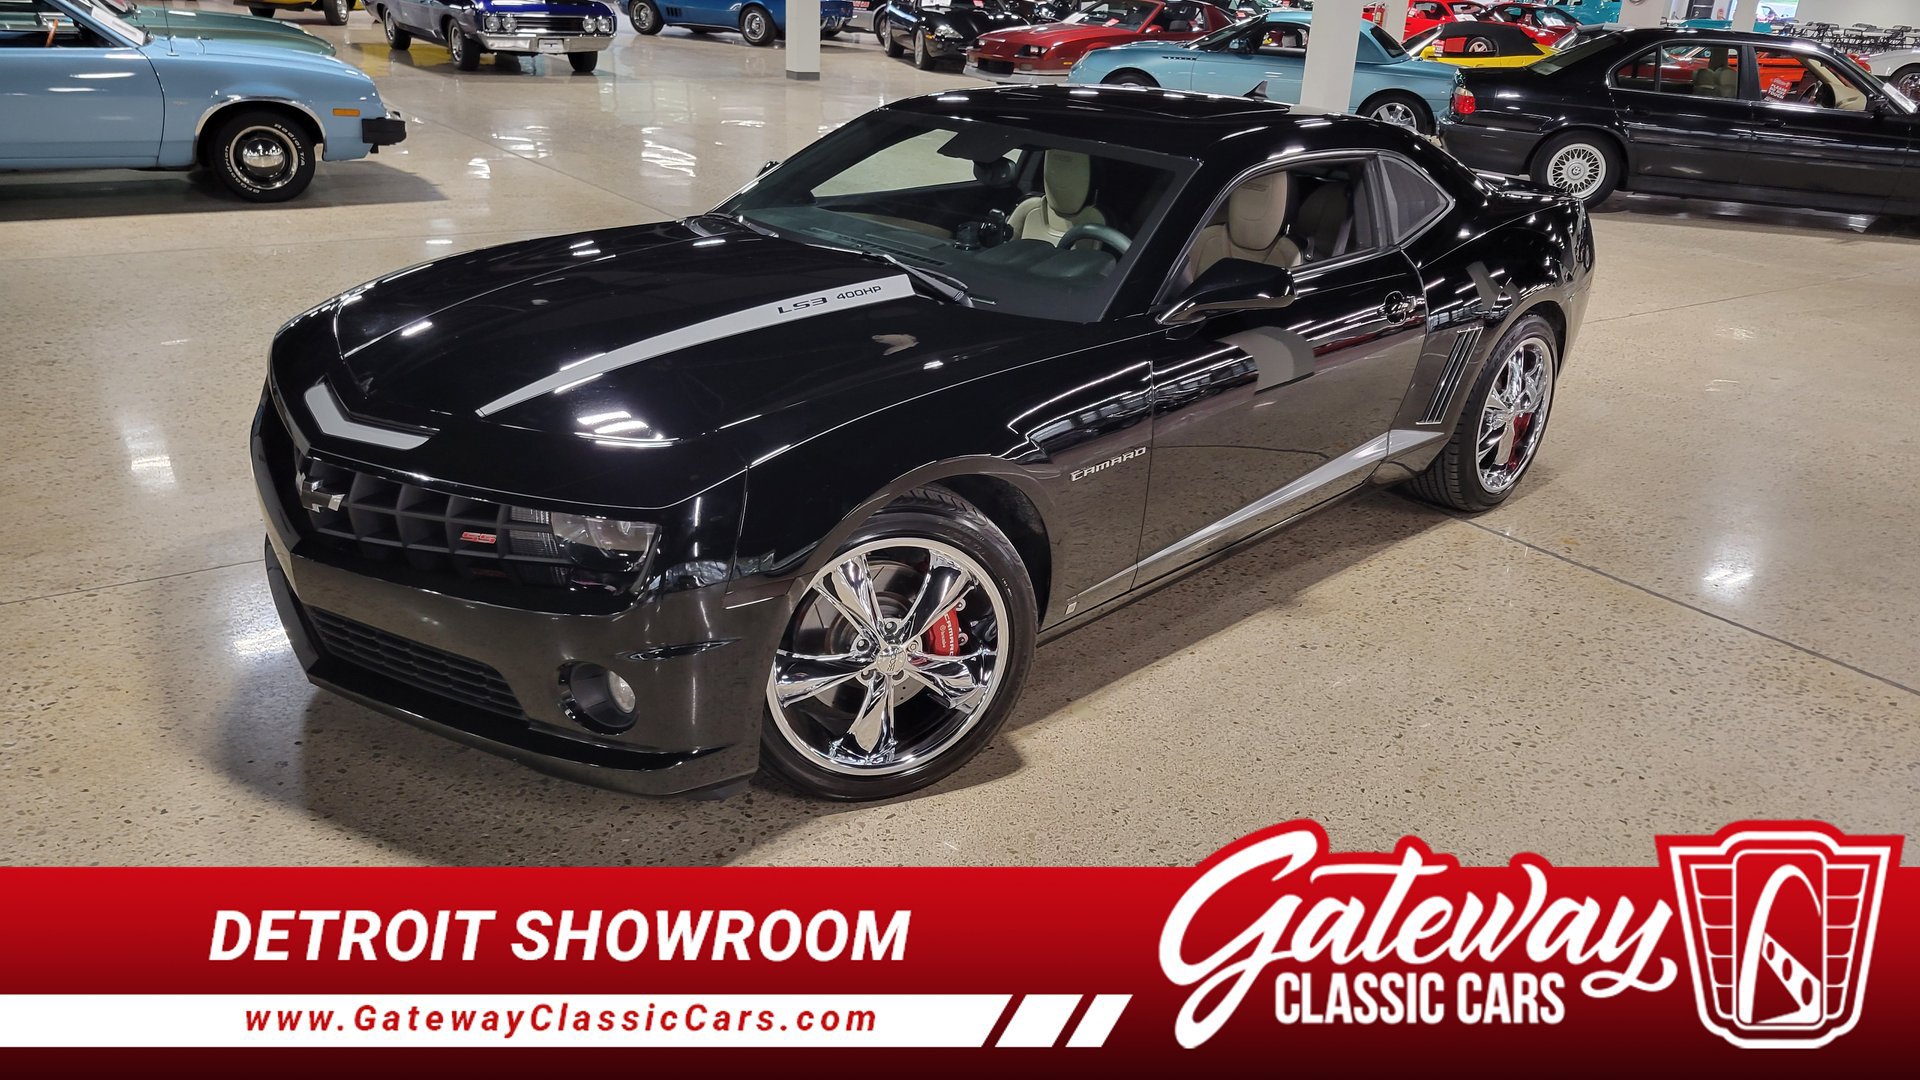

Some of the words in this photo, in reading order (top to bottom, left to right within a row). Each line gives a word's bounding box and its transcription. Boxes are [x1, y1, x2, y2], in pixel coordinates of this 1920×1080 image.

[777, 297, 828, 314] LS3
[837, 285, 882, 300] 400HP
[1070, 446, 1147, 482] CAMARO
[460, 531, 497, 544] SS
